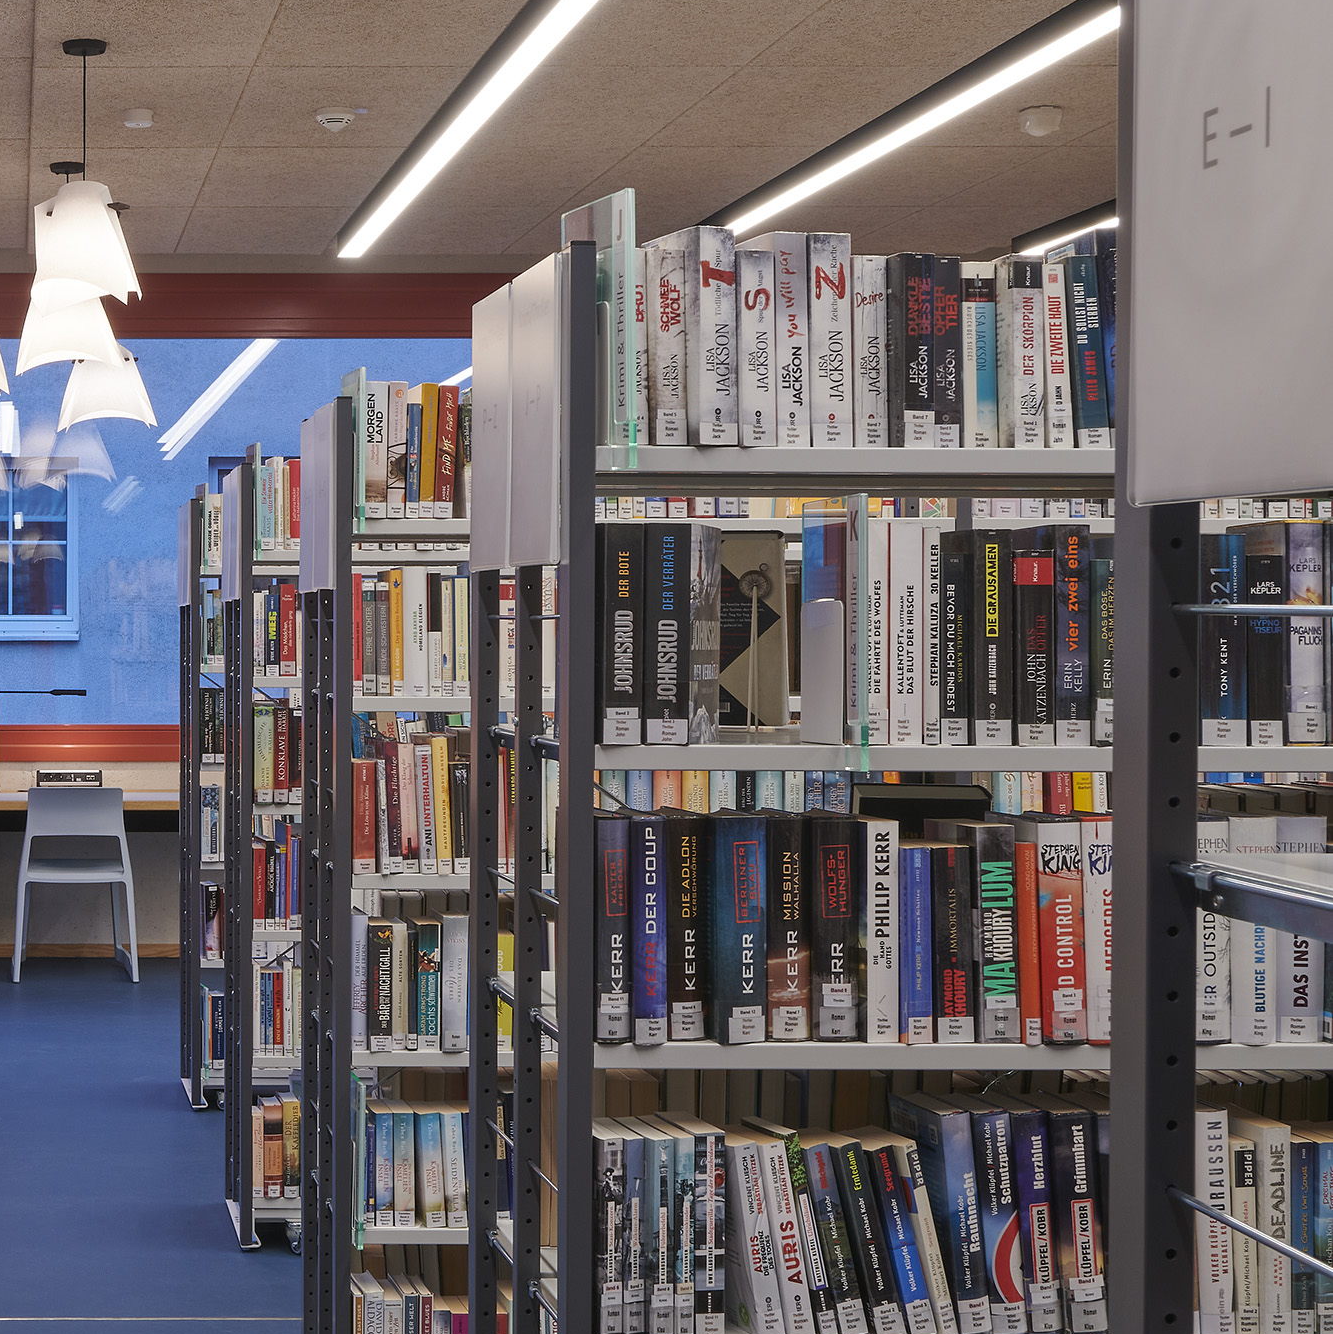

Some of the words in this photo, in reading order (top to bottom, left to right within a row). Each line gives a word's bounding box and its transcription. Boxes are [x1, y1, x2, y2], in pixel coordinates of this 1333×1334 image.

[1204, 107, 1218, 169] E
[660, 279, 670, 332] SCHNEE
[670, 284, 681, 326] WOLF
[854, 291, 884, 307] Desire
[1048, 295, 1061, 321] HAUT
[1087, 297, 1099, 329] STERBEN
[1023, 296, 1035, 350] SKORPION
[1050, 323, 1064, 355] ZWEITE
[706, 348, 715, 372] LISA
[716, 323, 730, 396] JACKSON
[782, 363, 791, 389] LISA
[791, 346, 803, 406] JACKSON
[1023, 355, 1035, 376] DER
[1051, 357, 1064, 374] DIE
[367, 393, 375, 444] MORGEN
[662, 536, 675, 587] VERRÄTER
[931, 544, 939, 581] KELLER
[1068, 535, 1078, 569] eins
[931, 583, 939, 595] 30
[987, 546, 997, 614] GRAUSAMEN
[1069, 577, 1079, 612] zwei
[1250, 587, 1281, 595] KEPLER
[662, 593, 674, 610] DER
[931, 602, 939, 640] KALUZA
[947, 584, 955, 620] BEVOR
[947, 624, 955, 637] DU
[988, 618, 997, 635] DIE
[1069, 620, 1079, 651] vier
[1299, 636, 1322, 645] FLUCH
[657, 619, 678, 703] JOHNSRUD
[930, 642, 939, 686] STEPHAN
[947, 641, 955, 668] MICH
[947, 672, 956, 712] FINDEST
[645, 827, 656, 886] COUP
[875, 830, 890, 876] KERR
[1042, 843, 1079, 855] STEPHEN
[1042, 851, 1081, 876] KING
[738, 846, 748, 918] BERLINER
[829, 854, 837, 909] WOLFS-
[645, 892, 656, 934] DER
[875, 882, 890, 938] PHILIP
[1056, 894, 1073, 968] CONTROL
[646, 942, 657, 996] KERR
[743, 933, 754, 994] KERR
[1255, 969, 1266, 1012] BLUTIGE
[1293, 975, 1309, 1008] DAS
[849, 1150, 863, 1191] Erntedank
[879, 1152, 894, 1192] Seegrund
[996, 1119, 1012, 1205] Schutzpatron
[1030, 1134, 1045, 1190] Herzblut
[1071, 1124, 1087, 1194] Grimmbart
[1244, 1154, 1253, 1186] PIPER
[1270, 1143, 1286, 1240] DEADLINE
[963, 1172, 981, 1254] Rauhnacht
[750, 1235, 763, 1273] AURIS
[780, 1220, 803, 1285] AURIS
